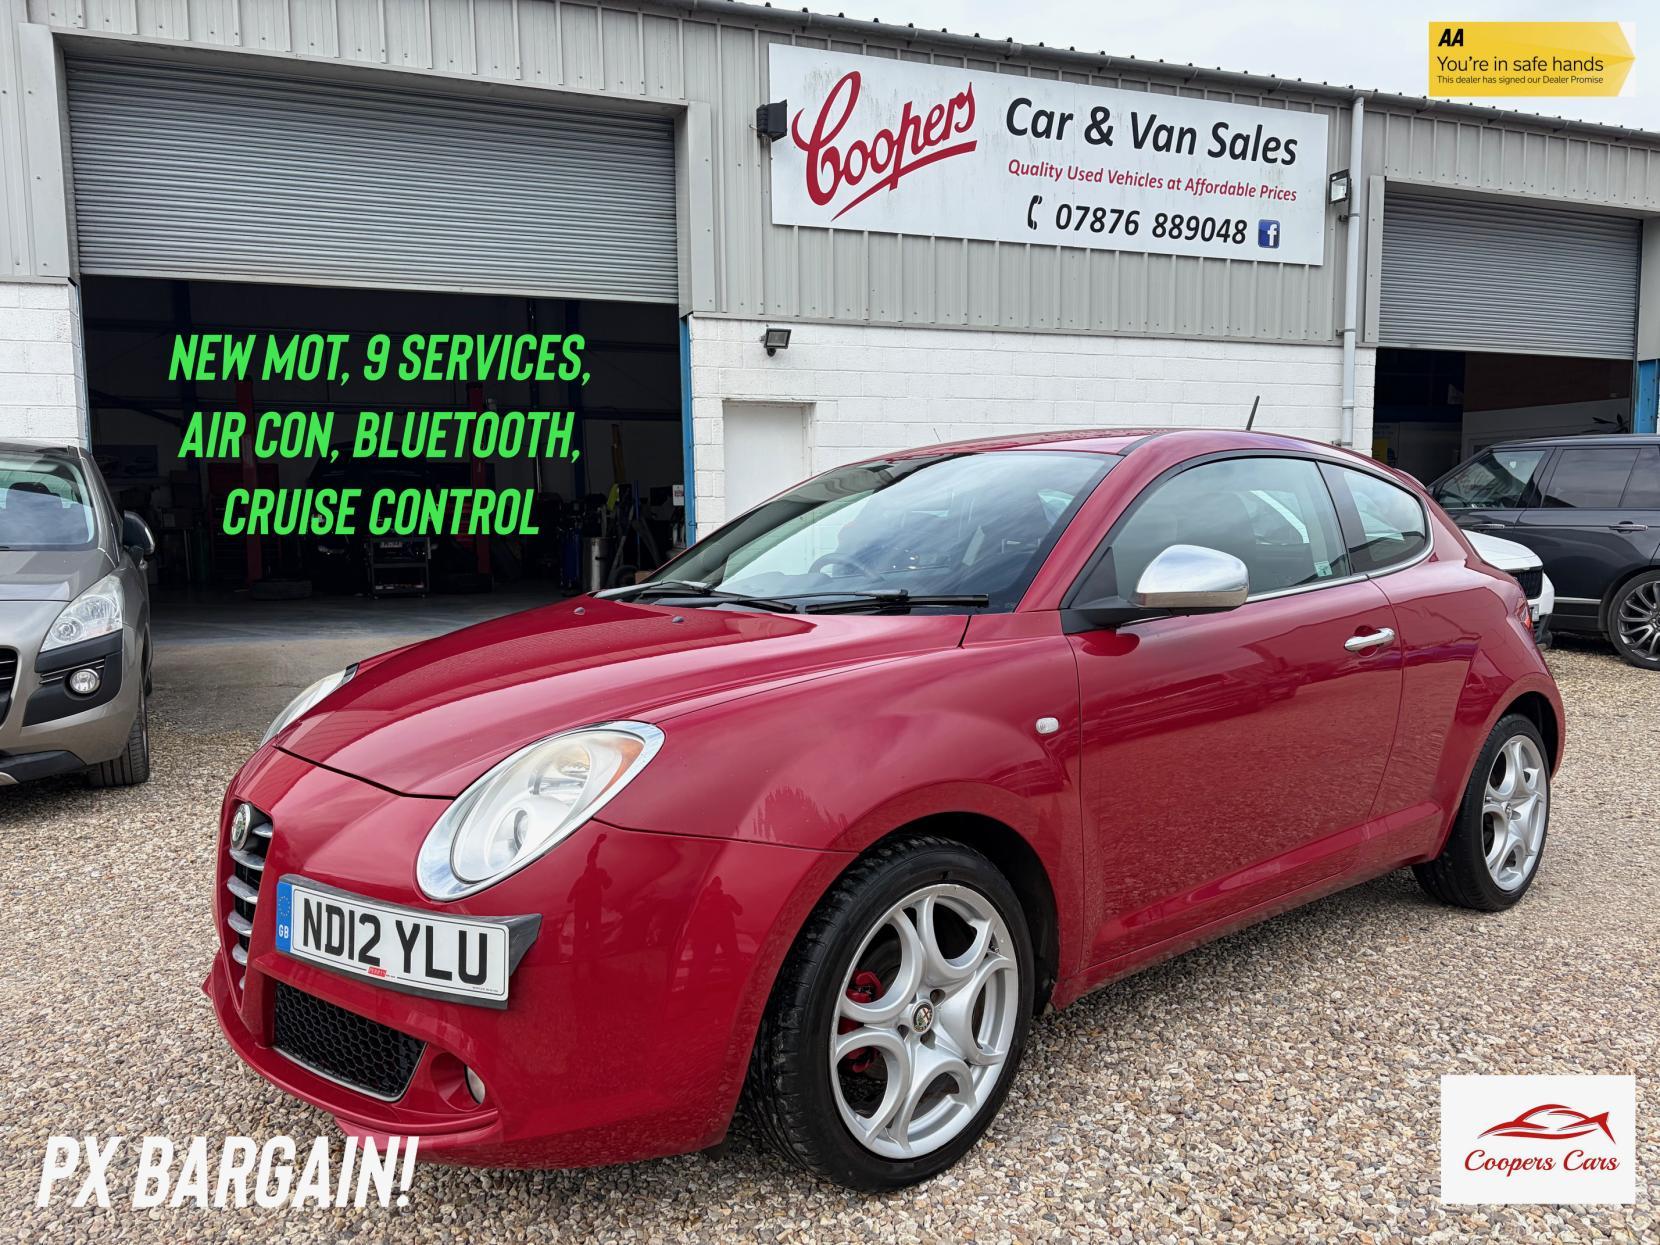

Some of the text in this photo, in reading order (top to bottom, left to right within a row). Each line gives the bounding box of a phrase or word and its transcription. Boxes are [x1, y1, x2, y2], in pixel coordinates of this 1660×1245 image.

[791, 70, 977, 210] Coopers
[1006, 97, 1298, 166] Car & Van Sales
[1008, 159, 1297, 201] Quality Used Vehicles at Affordable Prices
[1055, 203, 1248, 245] 07876 889048
[278, 924, 289, 939] GB
[303, 897, 488, 985] ND12 YLU
